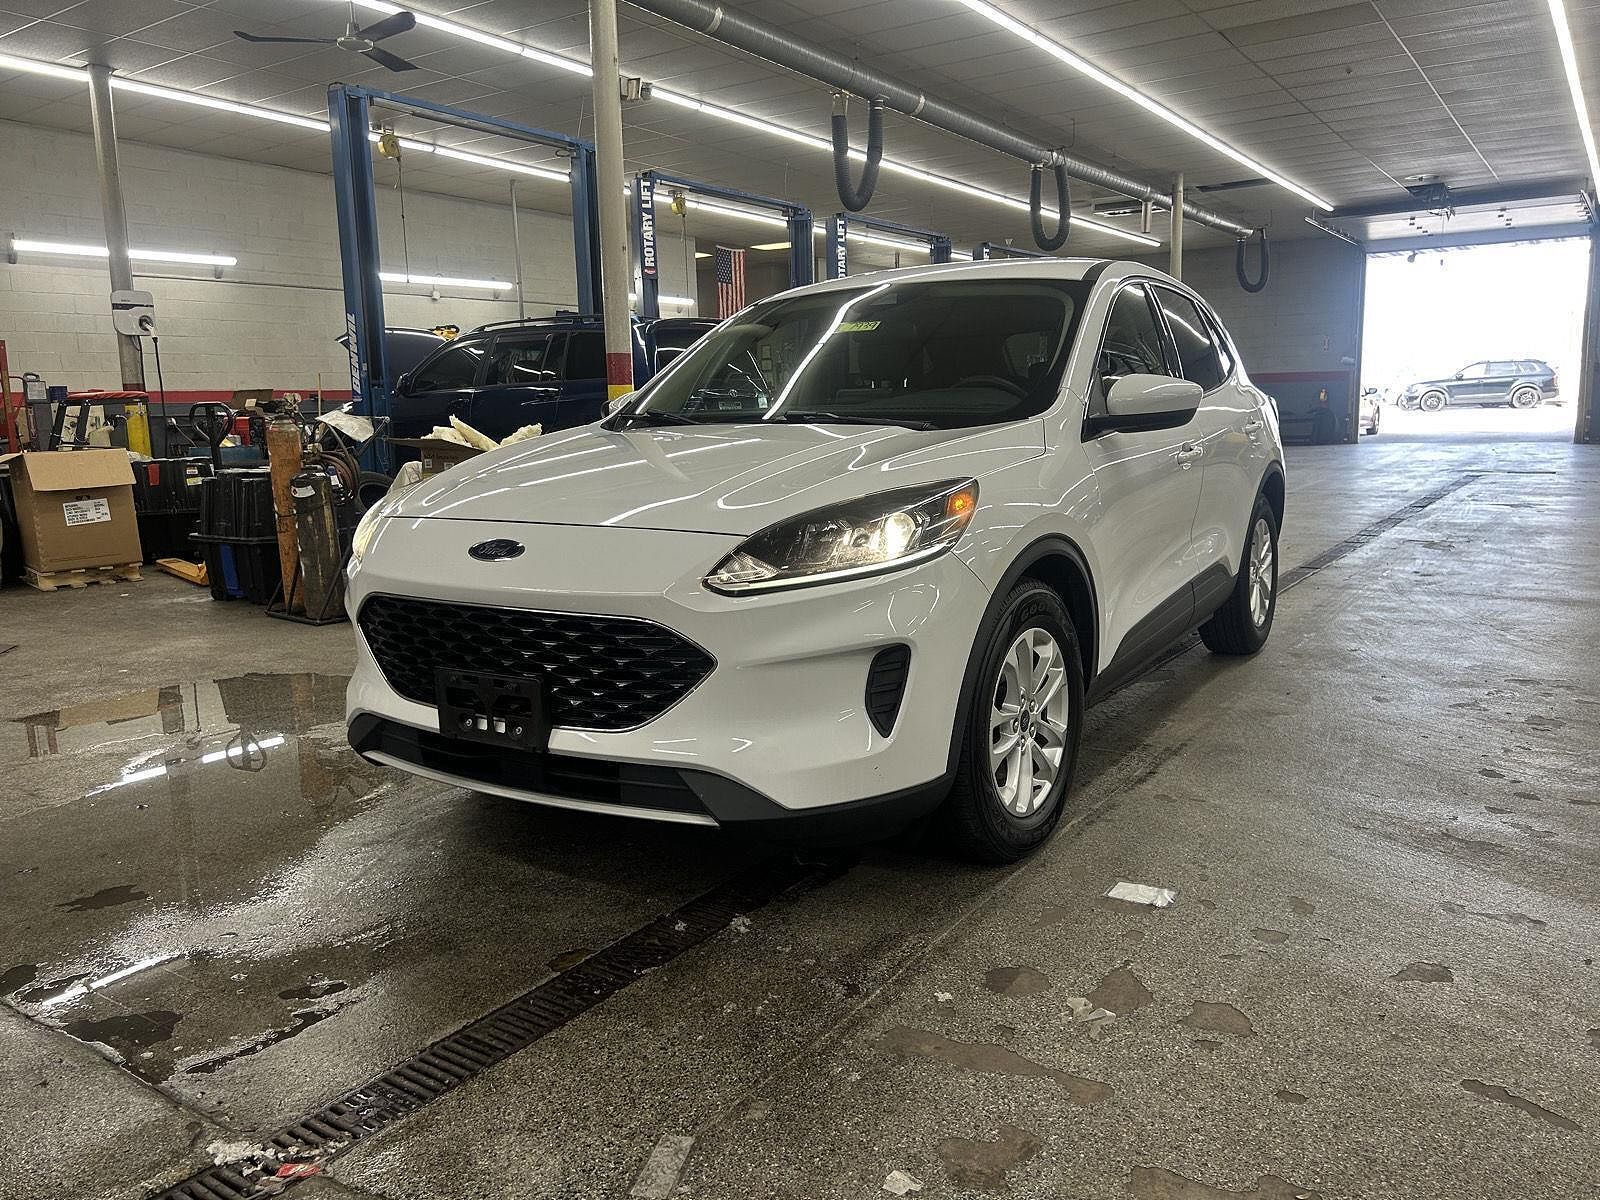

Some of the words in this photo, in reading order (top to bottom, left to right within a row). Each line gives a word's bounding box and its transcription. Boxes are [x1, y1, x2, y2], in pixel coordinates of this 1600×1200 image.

[640, 179, 652, 209] LIFT
[641, 211, 655, 267] ROTARY
[836, 218, 845, 242] LIFT
[836, 244, 847, 279] OTARY
